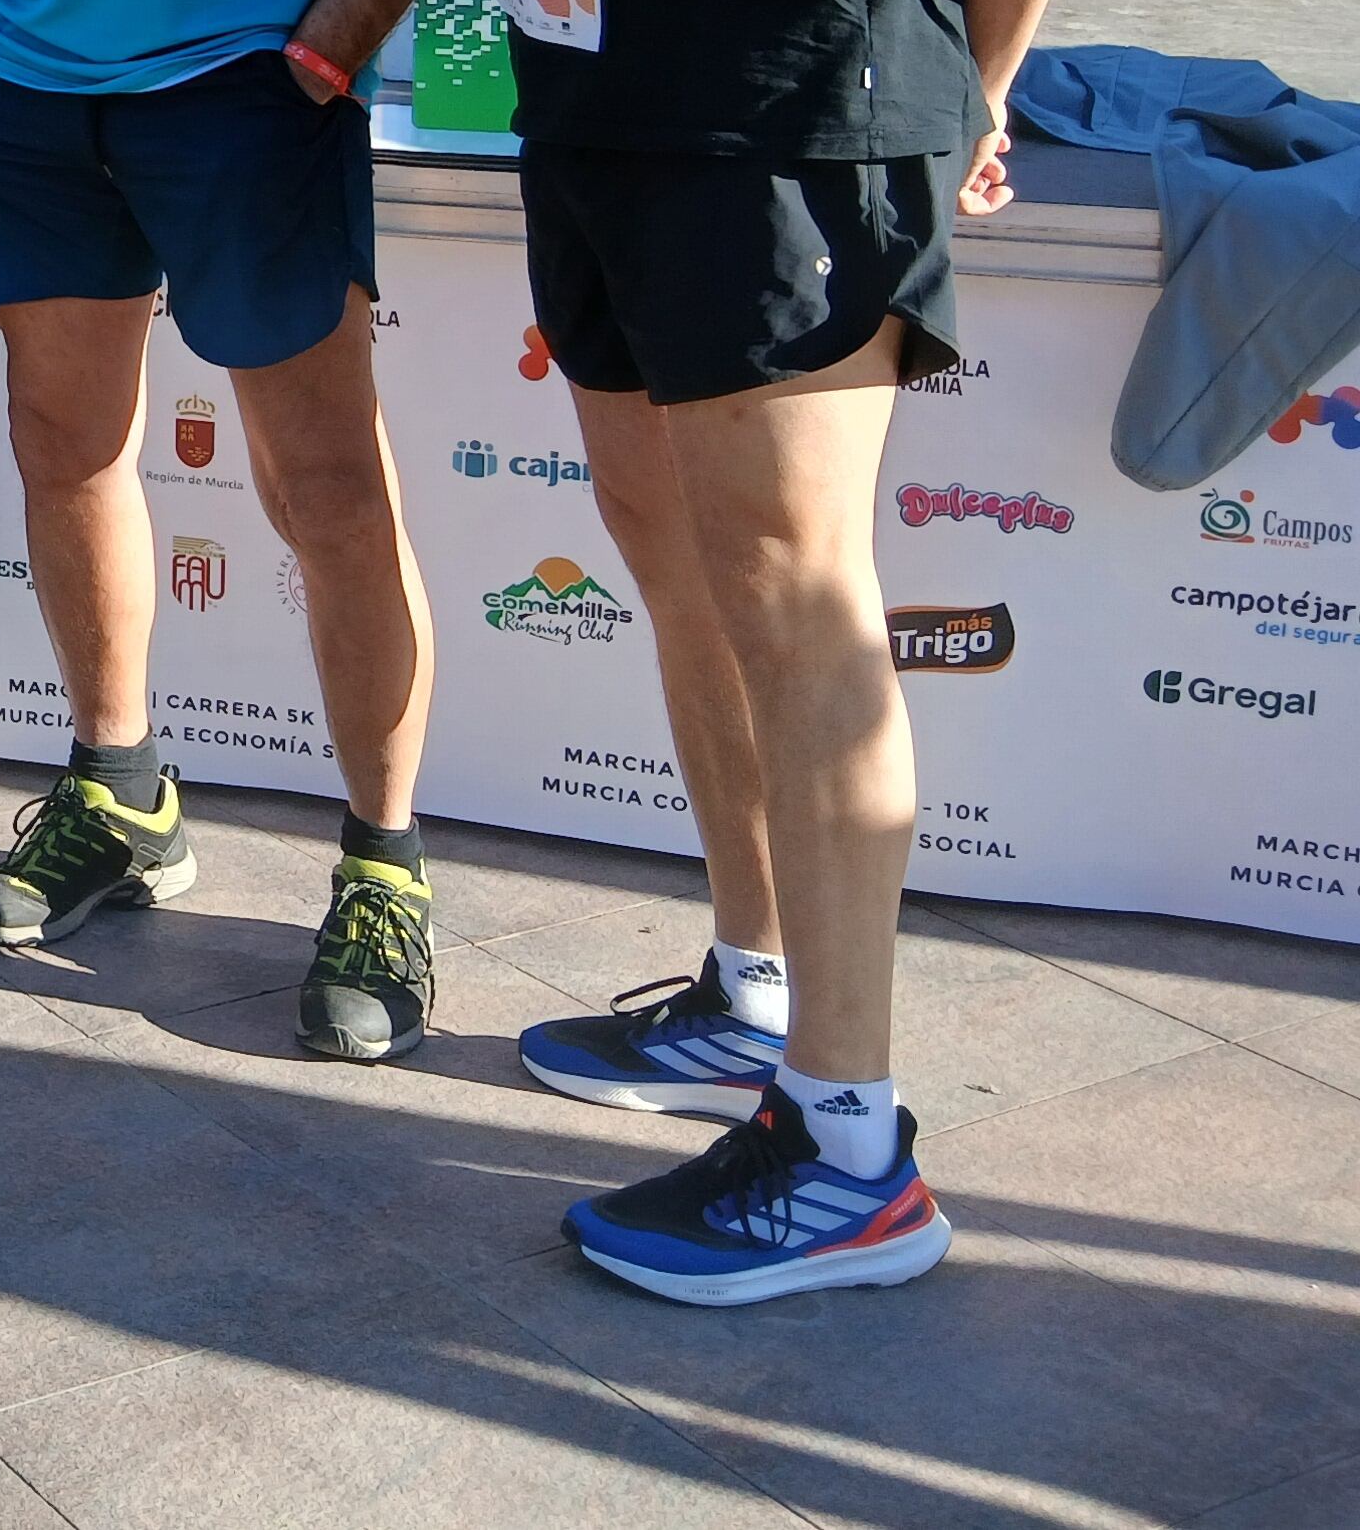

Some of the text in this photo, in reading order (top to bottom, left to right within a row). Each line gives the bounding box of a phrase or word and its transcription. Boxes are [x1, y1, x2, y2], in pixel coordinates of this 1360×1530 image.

[145, 470, 244, 490] Región de Murcia
[896, 483, 1075, 534] Dulceplus
[1262, 509, 1353, 545] Campos
[1262, 538, 1311, 550] FRUTAS
[482, 592, 634, 624] ComeMillas
[1171, 586, 1360, 624] campotéjar
[502, 612, 615, 646] Running Club
[945, 613, 993, 634] más
[1255, 621, 1286, 638] del
[892, 627, 994, 665] Trigo
[166, 693, 278, 721] CARRERA
[286, 708, 315, 727] 5K
[1188, 677, 1317, 719] Gregal
[183, 726, 313, 757] ECONOMÍA
[563, 746, 990, 823] MARCHA 10K
[541, 775, 643, 807] MURCIA
[918, 832, 1017, 860] SOCIAL
[1256, 835, 1360, 864] MARCH
[1230, 865, 1345, 896] MURCIA
[813, 1102, 870, 1116] adidas
